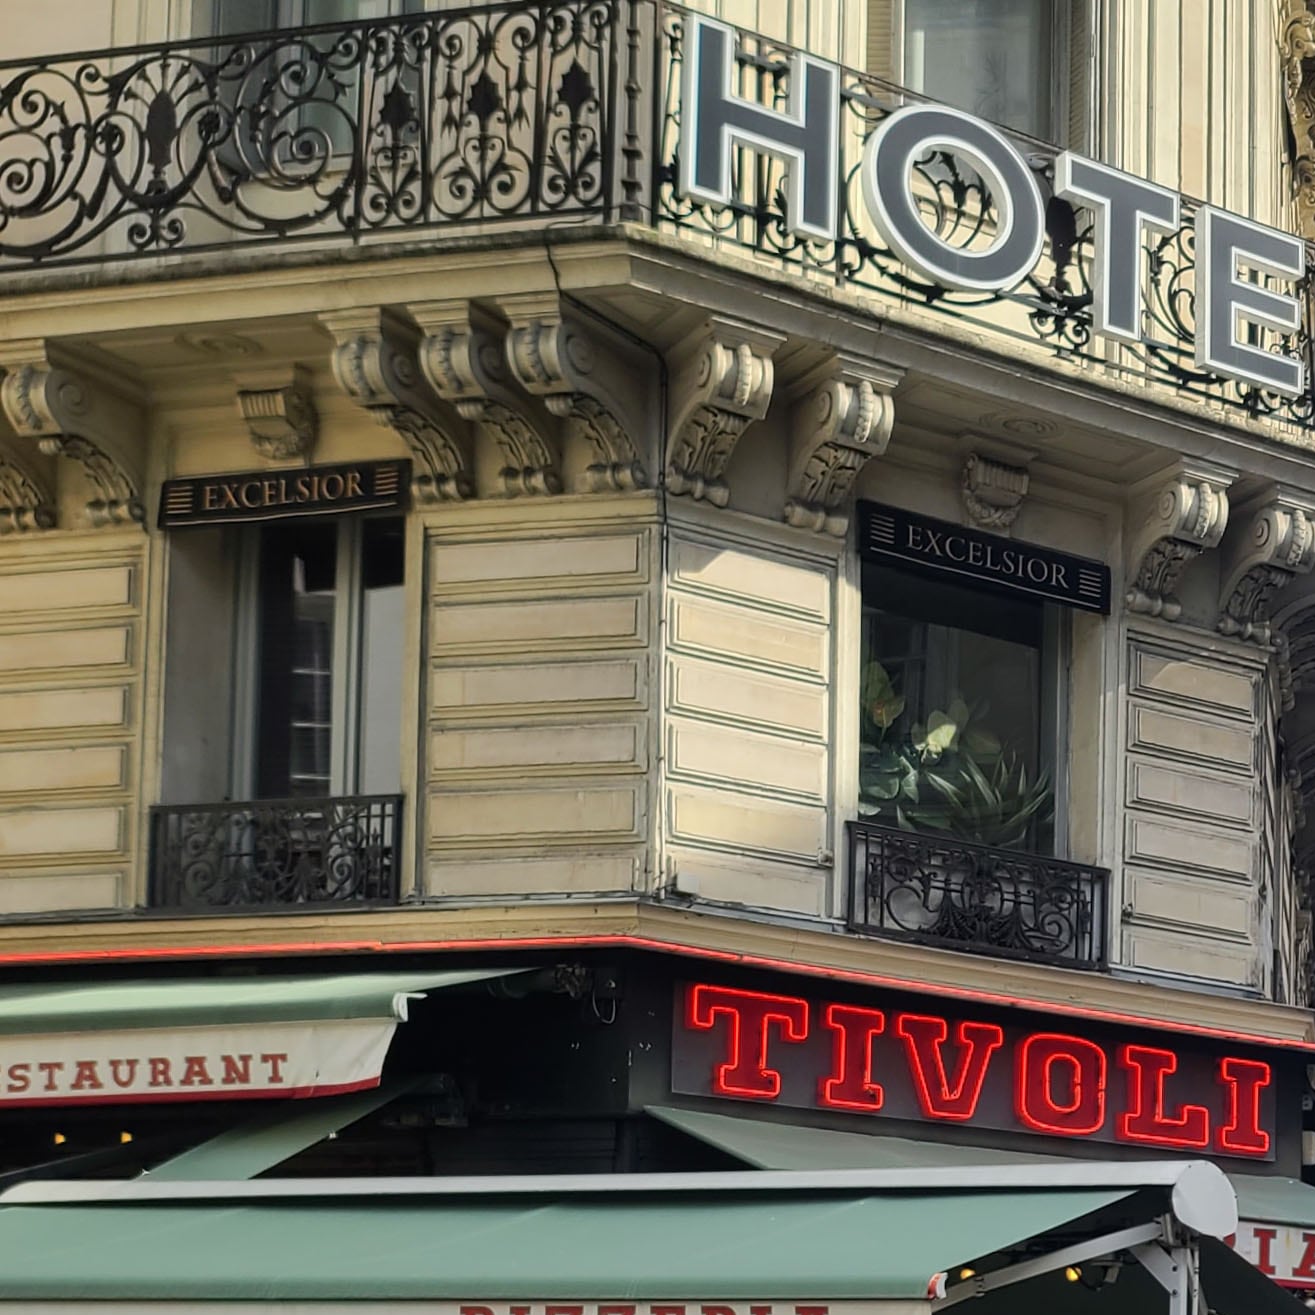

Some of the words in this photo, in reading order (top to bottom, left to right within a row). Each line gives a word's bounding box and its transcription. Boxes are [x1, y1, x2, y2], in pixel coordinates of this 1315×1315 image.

[203, 474, 364, 509] EXCELSIOR
[905, 526, 1070, 591] EXCELSIOR
[0, 1053, 288, 1093] STAURANT
[687, 984, 1271, 1154] TIVOLI
